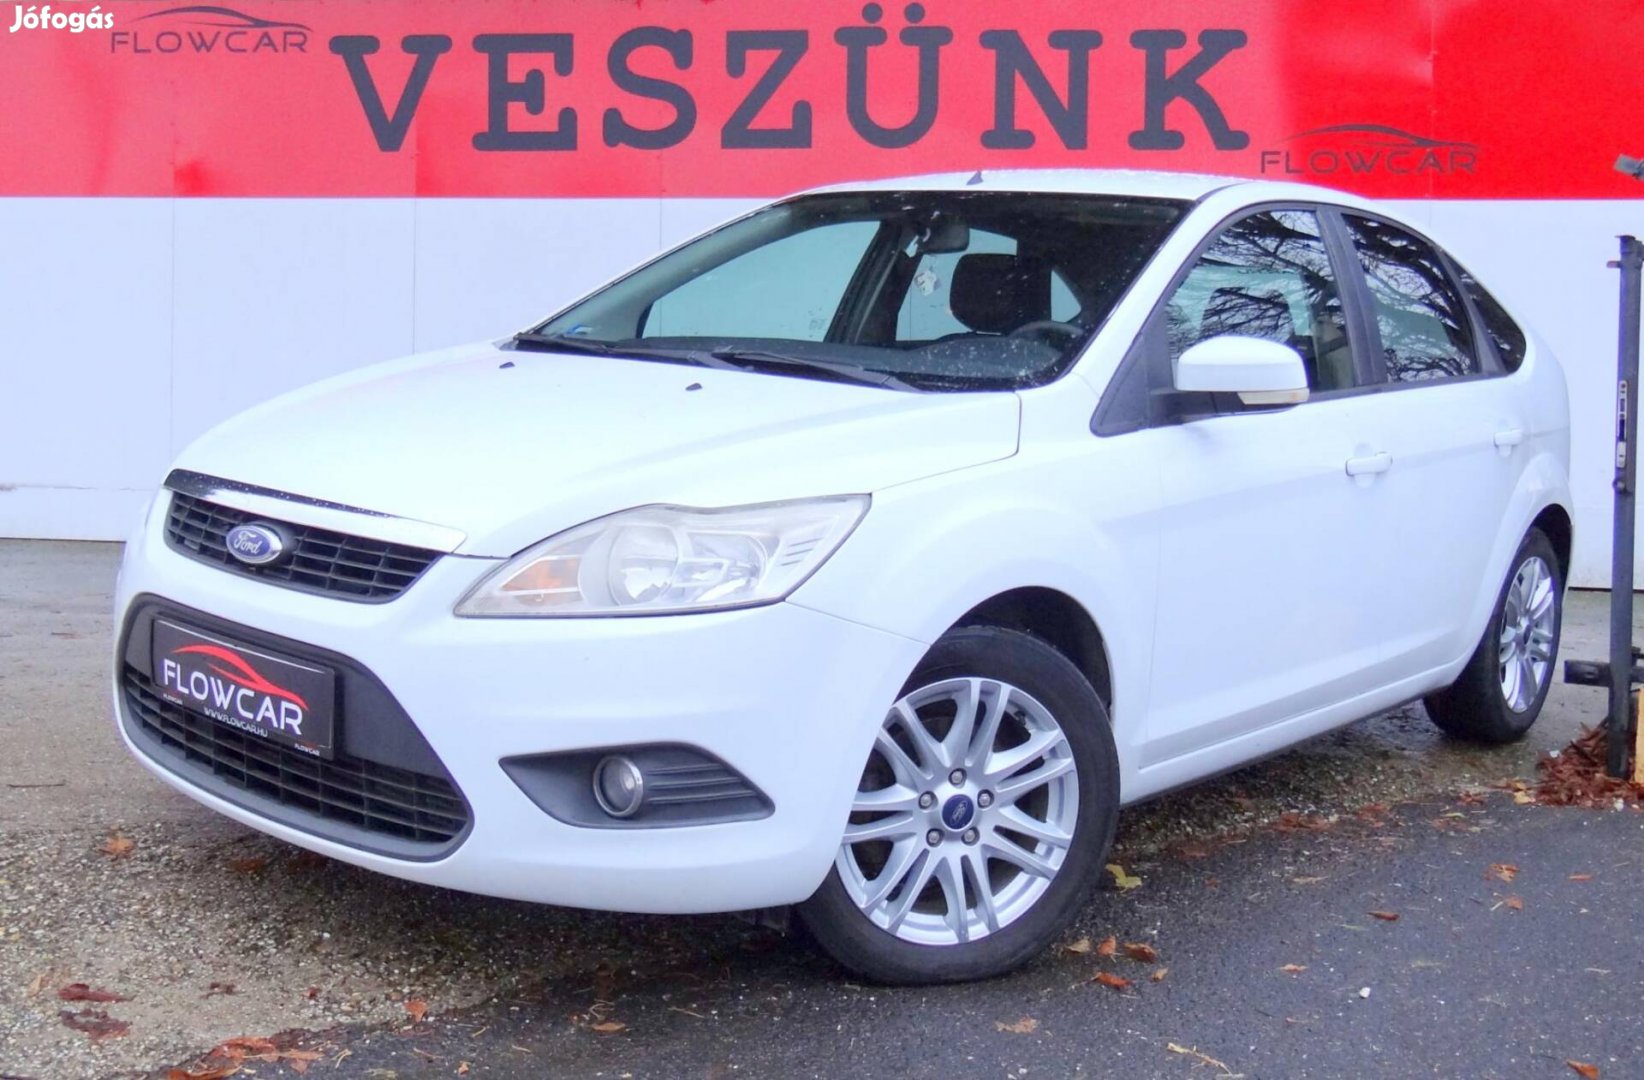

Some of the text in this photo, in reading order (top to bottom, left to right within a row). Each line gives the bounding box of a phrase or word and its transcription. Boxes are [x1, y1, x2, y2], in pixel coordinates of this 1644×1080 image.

[111, 31, 308, 54] FLOWCAR
[328, 2, 1250, 152] VESZÜNK
[1260, 151, 1477, 174] FLOWCAR
[233, 530, 263, 554] Ford
[163, 658, 303, 736] FLOWCAR
